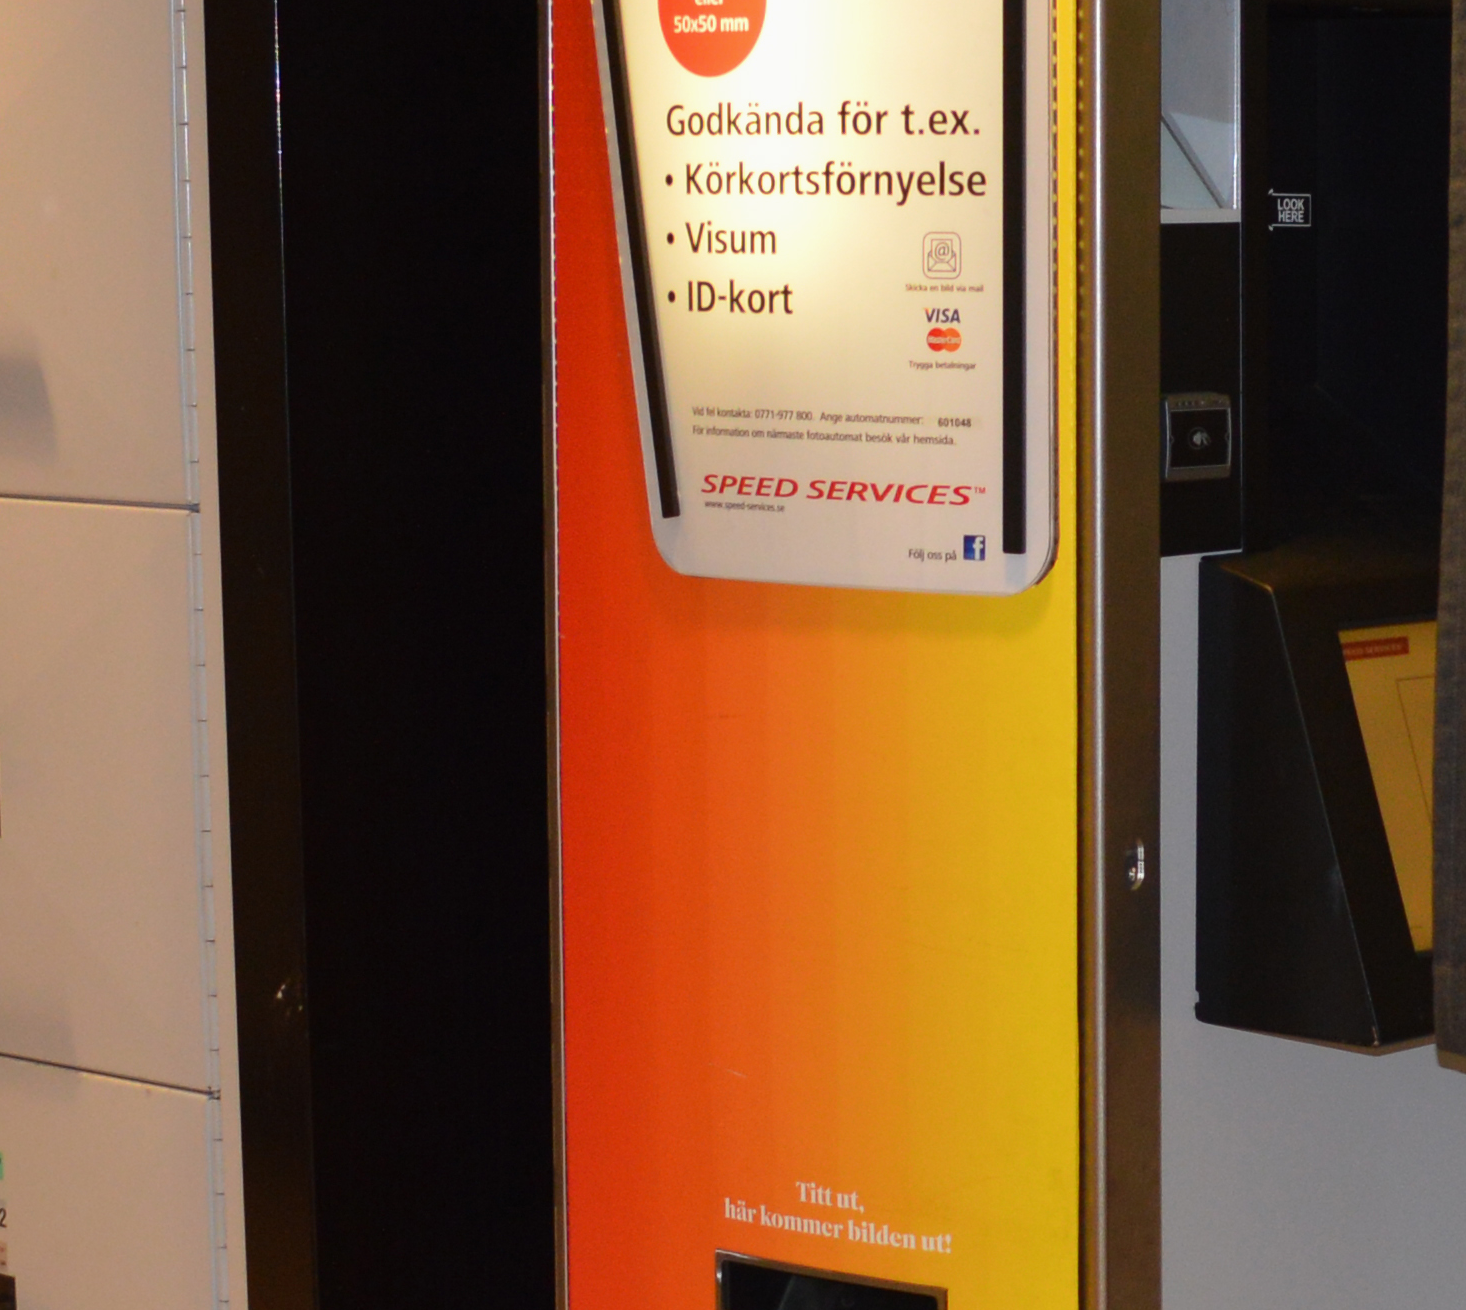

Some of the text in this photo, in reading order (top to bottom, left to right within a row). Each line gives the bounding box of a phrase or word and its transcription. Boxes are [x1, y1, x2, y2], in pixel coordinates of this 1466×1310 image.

[673, 14, 750, 35] 50x50 mm
[665, 100, 982, 137] Godkända för t.ex.
[684, 160, 988, 207] Körkortsförnyelse
[1277, 198, 1305, 210] LOOK
[1278, 210, 1305, 223] HERE
[684, 221, 778, 255] Visum
[685, 279, 794, 316] ID-kort
[905, 283, 928, 293] Skicka
[929, 284, 939, 293] en
[940, 283, 955, 293] bild
[968, 284, 985, 293] mail
[923, 307, 961, 324] VISA
[908, 359, 977, 372] Trygga betalningar
[691, 405, 705, 417] Vid
[706, 406, 716, 418] fel
[754, 408, 795, 421] 0771-977
[819, 411, 843, 425] Ange
[692, 424, 705, 436] För
[706, 425, 750, 439] information
[751, 429, 765, 439] om
[766, 428, 805, 440] närmaste
[806, 429, 863, 443] fotoautomat
[864, 432, 893, 444] besök
[895, 432, 911, 444] vår
[700, 473, 799, 498] SPEED
[908, 548, 925, 562] Följ
[926, 550, 943, 561] oss
[944, 549, 957, 563] på
[795, 1181, 865, 1214] Titt ut,
[723, 1197, 953, 1254] här kommer bilden ut!
